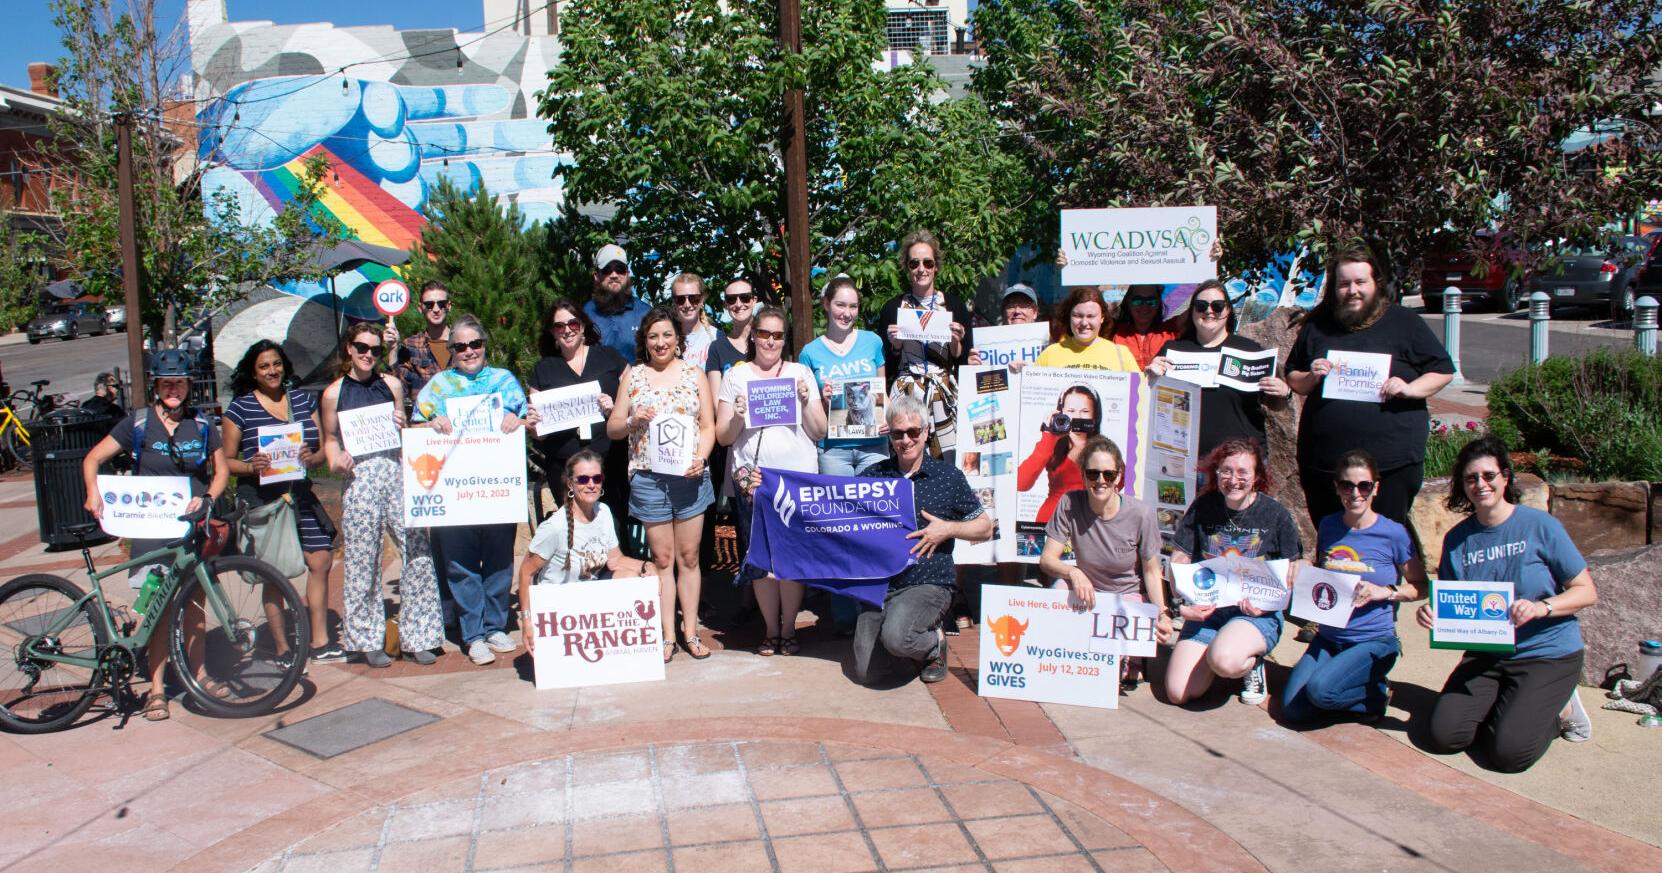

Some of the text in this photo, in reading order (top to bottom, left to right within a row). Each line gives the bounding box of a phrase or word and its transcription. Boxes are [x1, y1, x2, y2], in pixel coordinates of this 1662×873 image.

[1070, 229, 1189, 250] WCADVSA
[1145, 250, 1168, 258] Against
[379, 289, 403, 303] ark
[978, 344, 1046, 366] Pilot Hi
[819, 358, 872, 380] LAWS
[1026, 370, 1041, 378] Cyber
[1339, 364, 1377, 380] Family
[752, 384, 792, 394] WYOMING
[1338, 377, 1383, 389] Promise
[543, 392, 598, 412] HOSPICE
[749, 391, 796, 401] CHILDREN'S
[763, 398, 782, 406] LAW
[754, 405, 789, 415] CENTER,
[764, 412, 782, 420] INC.
[848, 427, 865, 435] LAWS
[362, 438, 399, 452] CENTER
[426, 438, 442, 446] Live
[443, 437, 463, 446] Here,
[464, 436, 482, 445] Give
[658, 446, 684, 457] SAFE
[658, 456, 684, 465] Project
[444, 476, 522, 489] WyoGives.org
[457, 488, 510, 500] July 12, 2023
[799, 480, 899, 502] EPILEPSY
[412, 494, 444, 505] WYO
[410, 506, 446, 517] GIVES
[801, 498, 900, 516] FOUNDATION
[113, 510, 146, 519] Laramie
[804, 521, 904, 533] COLORADO & WYOMING
[1462, 540, 1527, 567] LIVE UNITED
[1242, 570, 1281, 589] Family
[1439, 592, 1478, 604] United
[1008, 598, 1025, 607] Live
[1027, 600, 1050, 609] Here,
[1051, 601, 1070, 611] Give
[617, 611, 633, 619] ON
[1454, 604, 1478, 619] Way
[535, 611, 616, 638] HOME
[617, 618, 640, 628] THE
[1091, 612, 1157, 642] LRH
[1478, 628, 1498, 636] Albany
[563, 627, 657, 663] RANGE
[1026, 645, 1115, 665] WyoGives.org
[989, 661, 1024, 674] WYO
[1037, 662, 1100, 677] July 12, 2023
[987, 674, 1026, 688] GIVES
